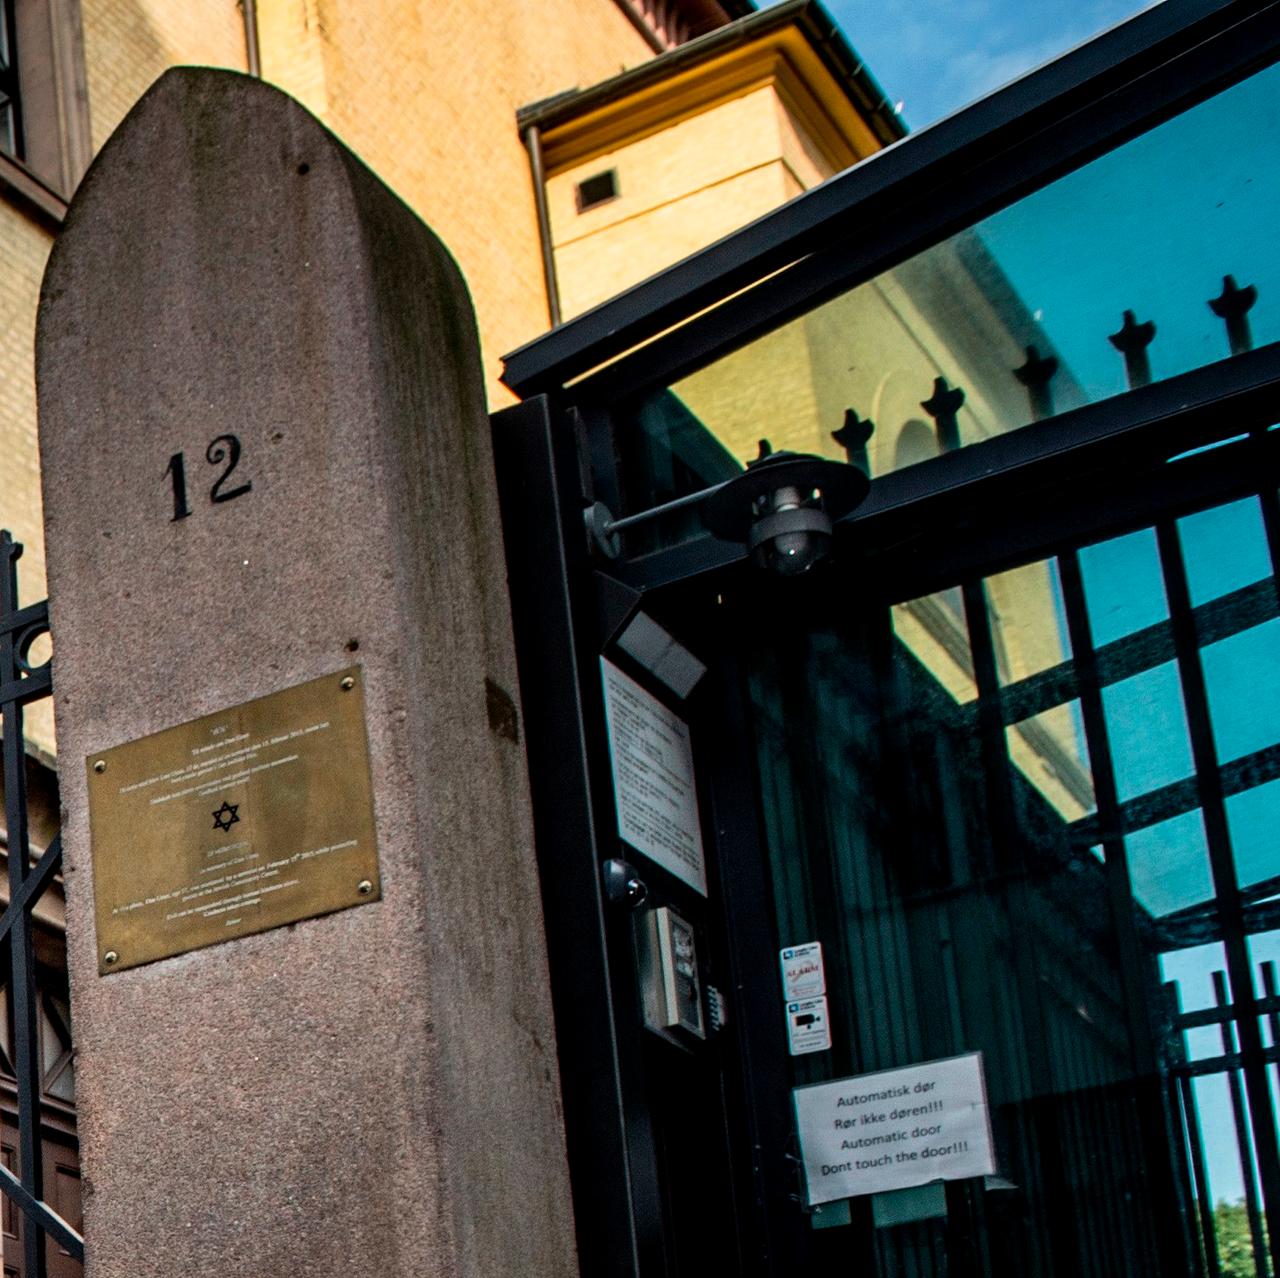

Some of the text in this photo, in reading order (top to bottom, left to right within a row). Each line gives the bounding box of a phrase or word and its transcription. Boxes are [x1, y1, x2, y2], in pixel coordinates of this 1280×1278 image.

[161, 434, 252, 523] 12
[836, 1080, 936, 1108] Automatisk dør
[834, 1100, 943, 1131] Rør ikke døren!!!
[841, 1124, 943, 1151] Automatic door
[821, 1141, 968, 1177] Dont touch the door!!!
